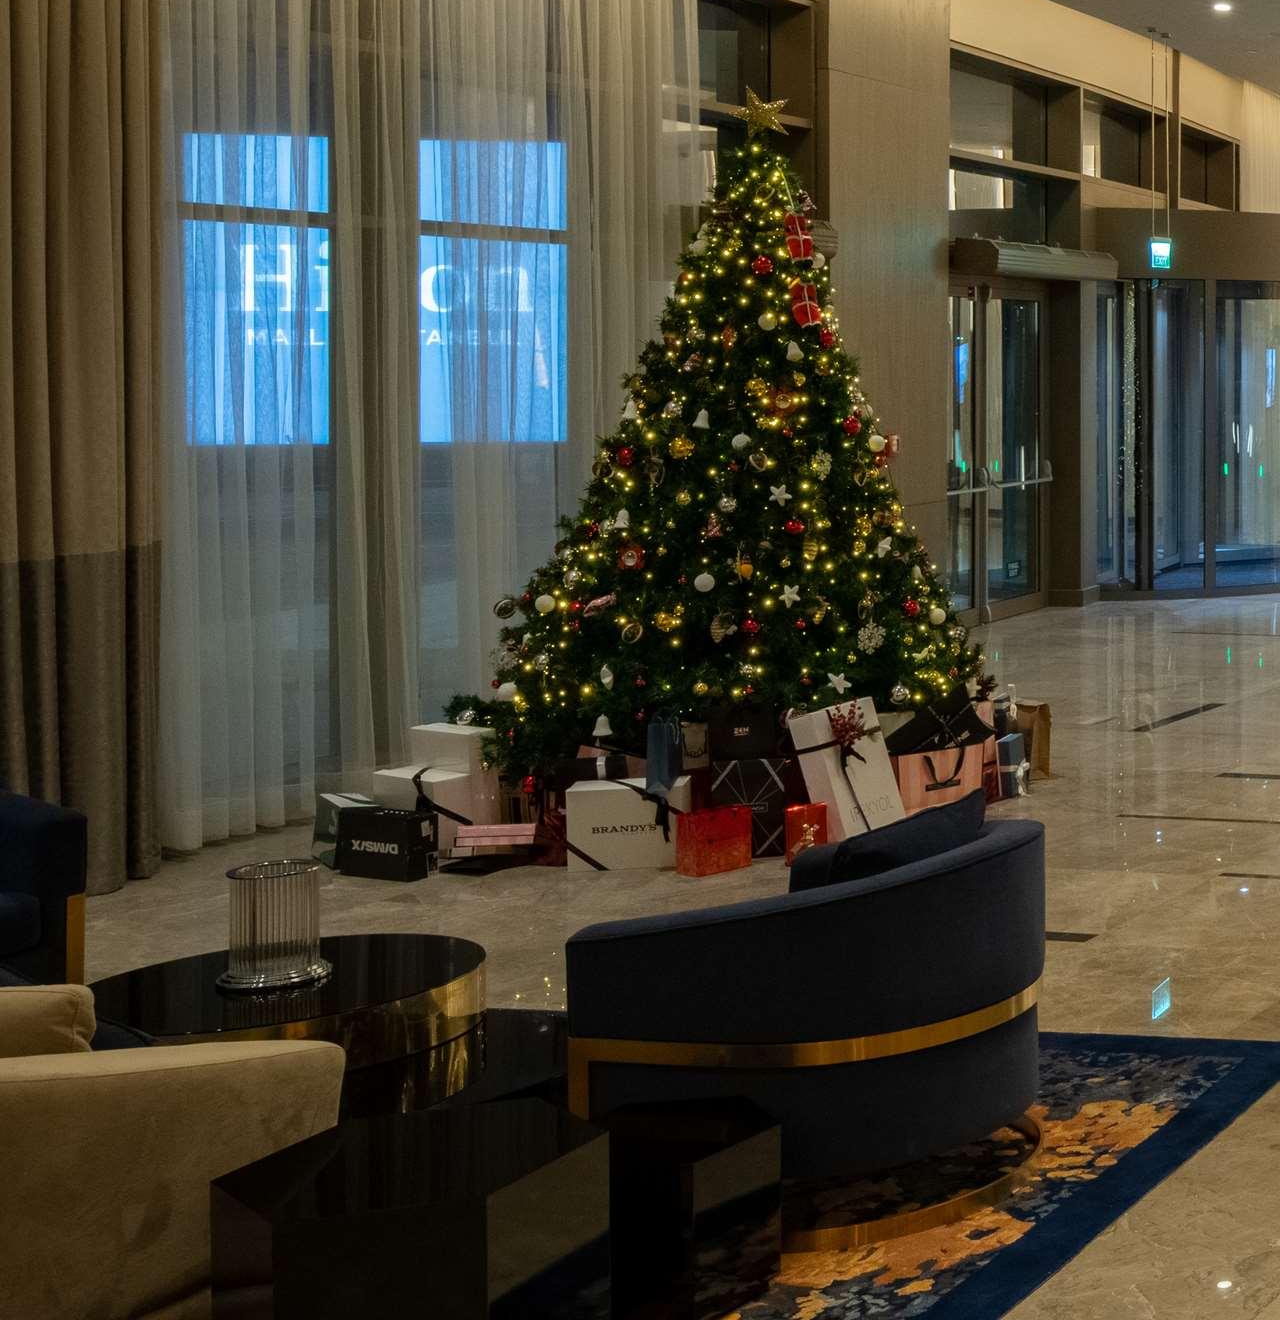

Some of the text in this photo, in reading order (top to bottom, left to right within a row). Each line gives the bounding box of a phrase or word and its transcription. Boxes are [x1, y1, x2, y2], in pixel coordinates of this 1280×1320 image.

[239, 239, 534, 312] Hion
[247, 328, 326, 346] MAL
[591, 823, 657, 835] BRANDY'S
